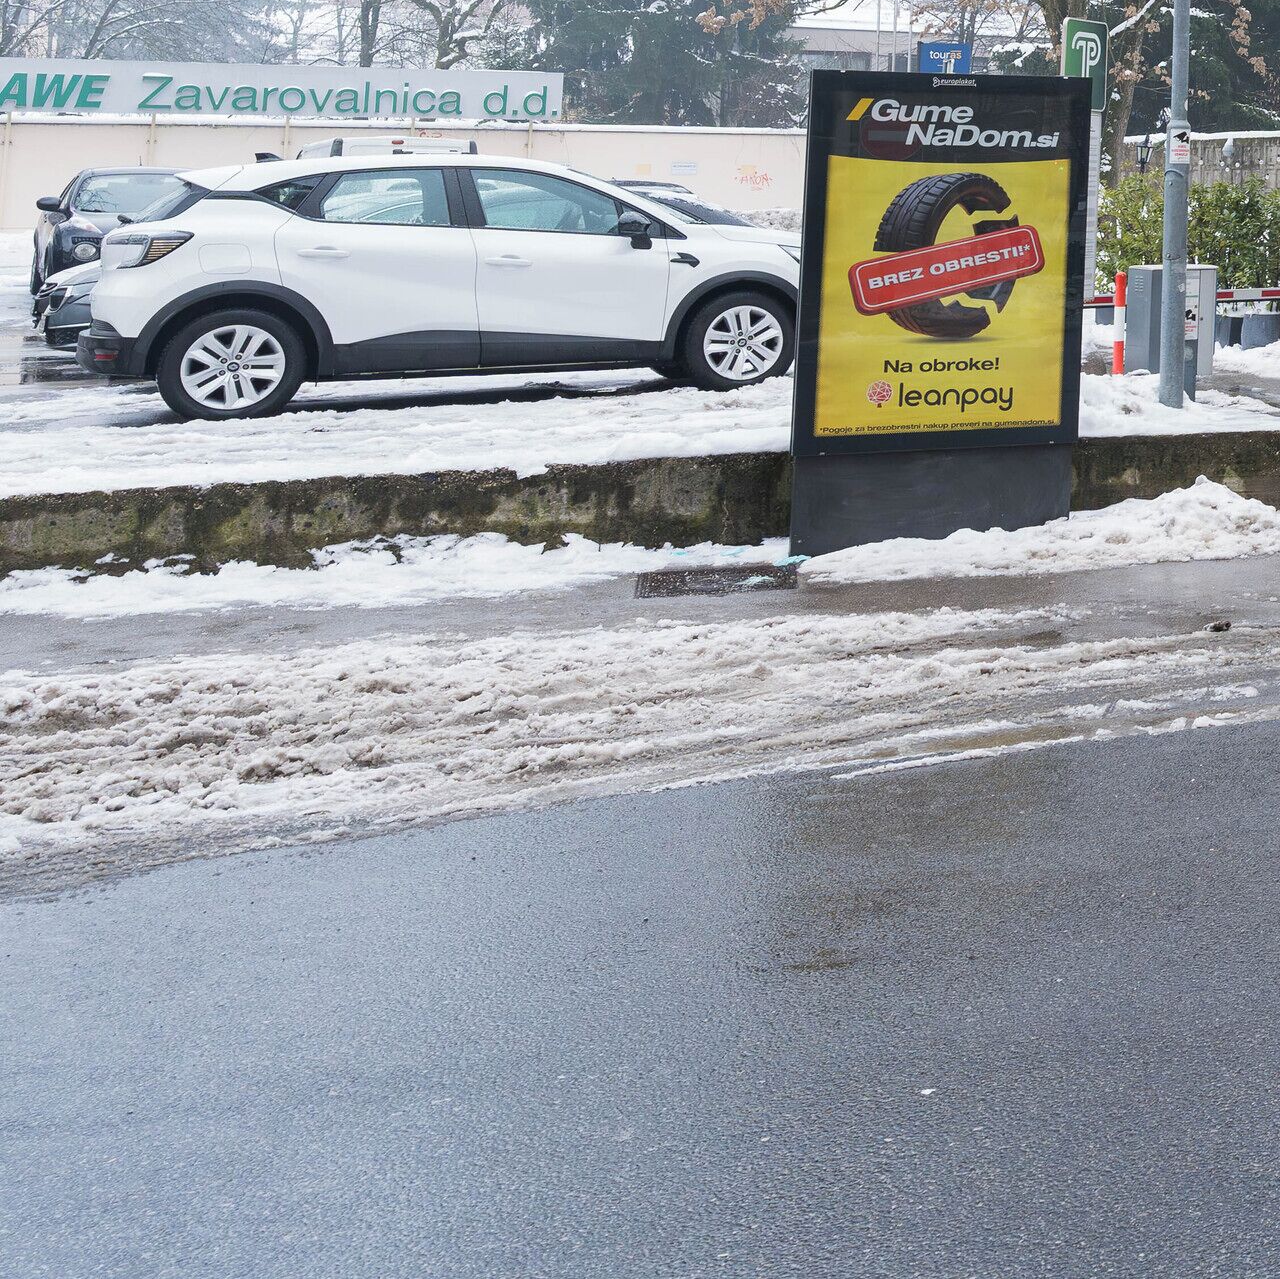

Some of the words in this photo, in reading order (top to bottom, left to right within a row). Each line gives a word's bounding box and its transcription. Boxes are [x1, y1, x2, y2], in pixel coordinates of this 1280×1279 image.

[929, 49, 962, 60] touras
[0, 73, 111, 109] AWE
[137, 73, 463, 116] Zavarovalnica
[483, 85, 558, 116] d.d.
[870, 98, 974, 124] Gume
[905, 123, 1060, 149] NaDom.si
[868, 267, 925, 290] BREZ
[883, 360, 913, 373] Na
[919, 357, 1000, 372] obroke!
[898, 382, 1014, 413] leanpay
[867, 423, 921, 432] brezobrestni
[923, 422, 949, 430] nakup
